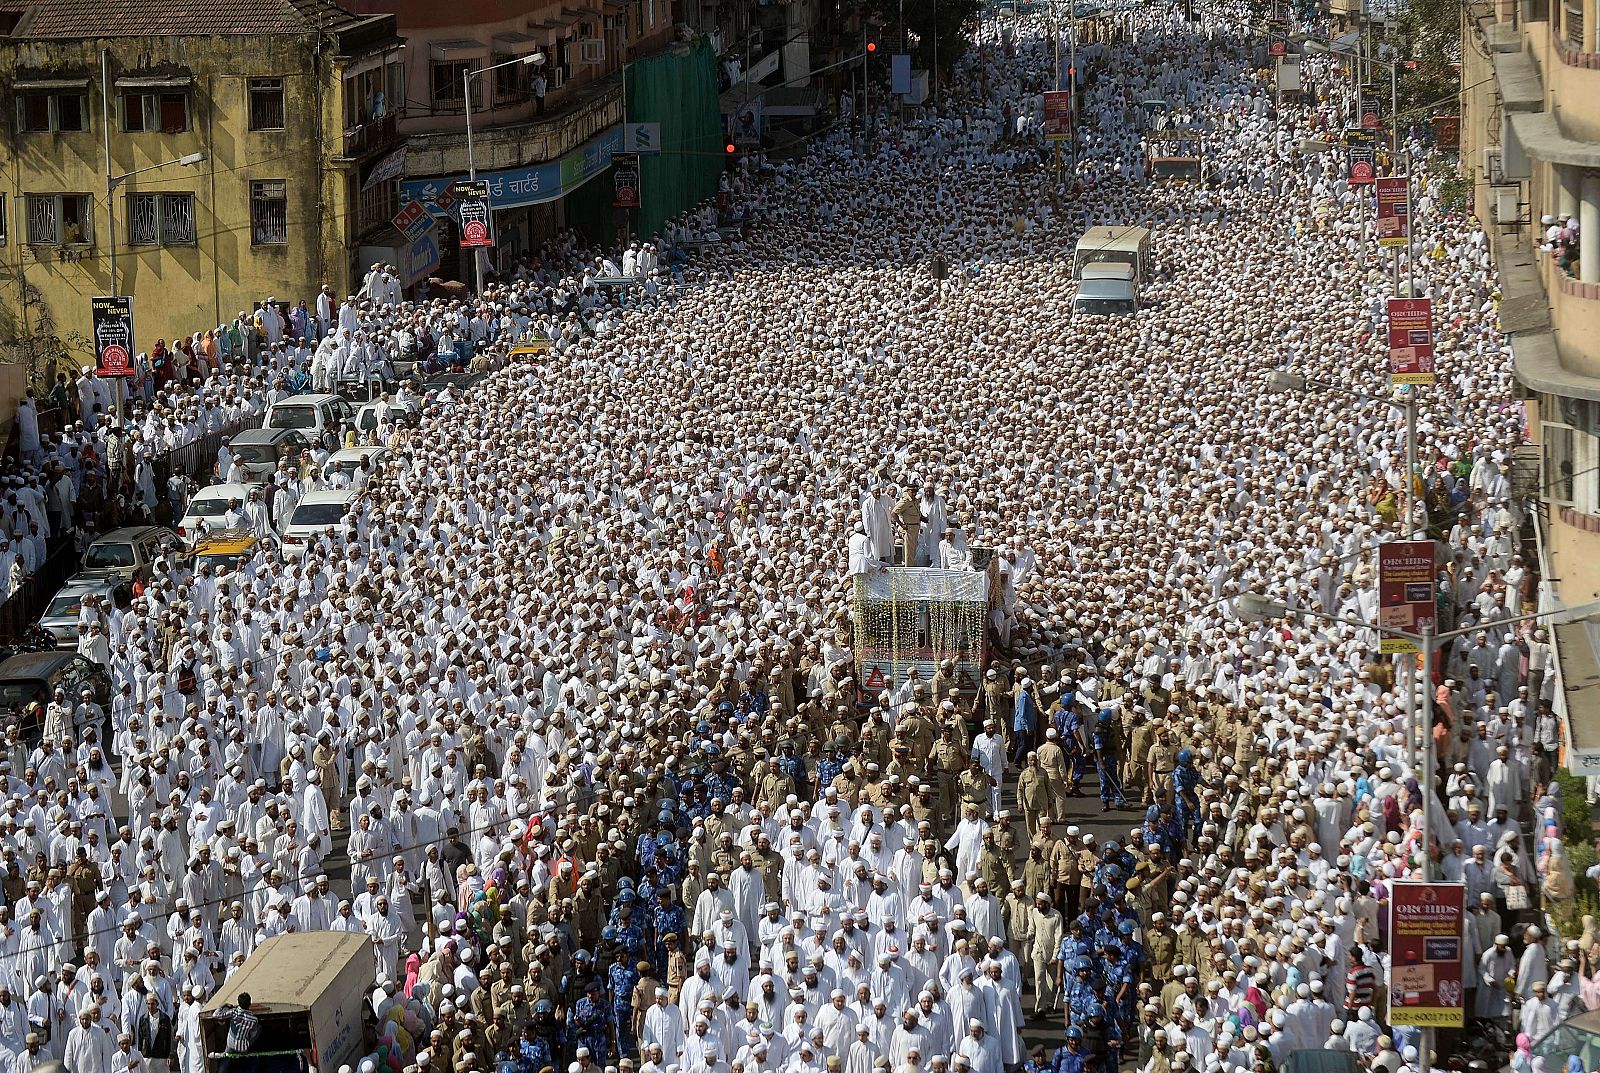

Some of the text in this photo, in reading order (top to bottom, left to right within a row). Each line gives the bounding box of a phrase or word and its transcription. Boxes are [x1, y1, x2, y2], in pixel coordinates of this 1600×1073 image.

[509, 172, 538, 193] चार्टर्ड
[405, 213, 429, 236] Domino's
[1396, 904, 1459, 913] ORCHIDS
[1391, 1012, 1461, 1021] 022-60017100
